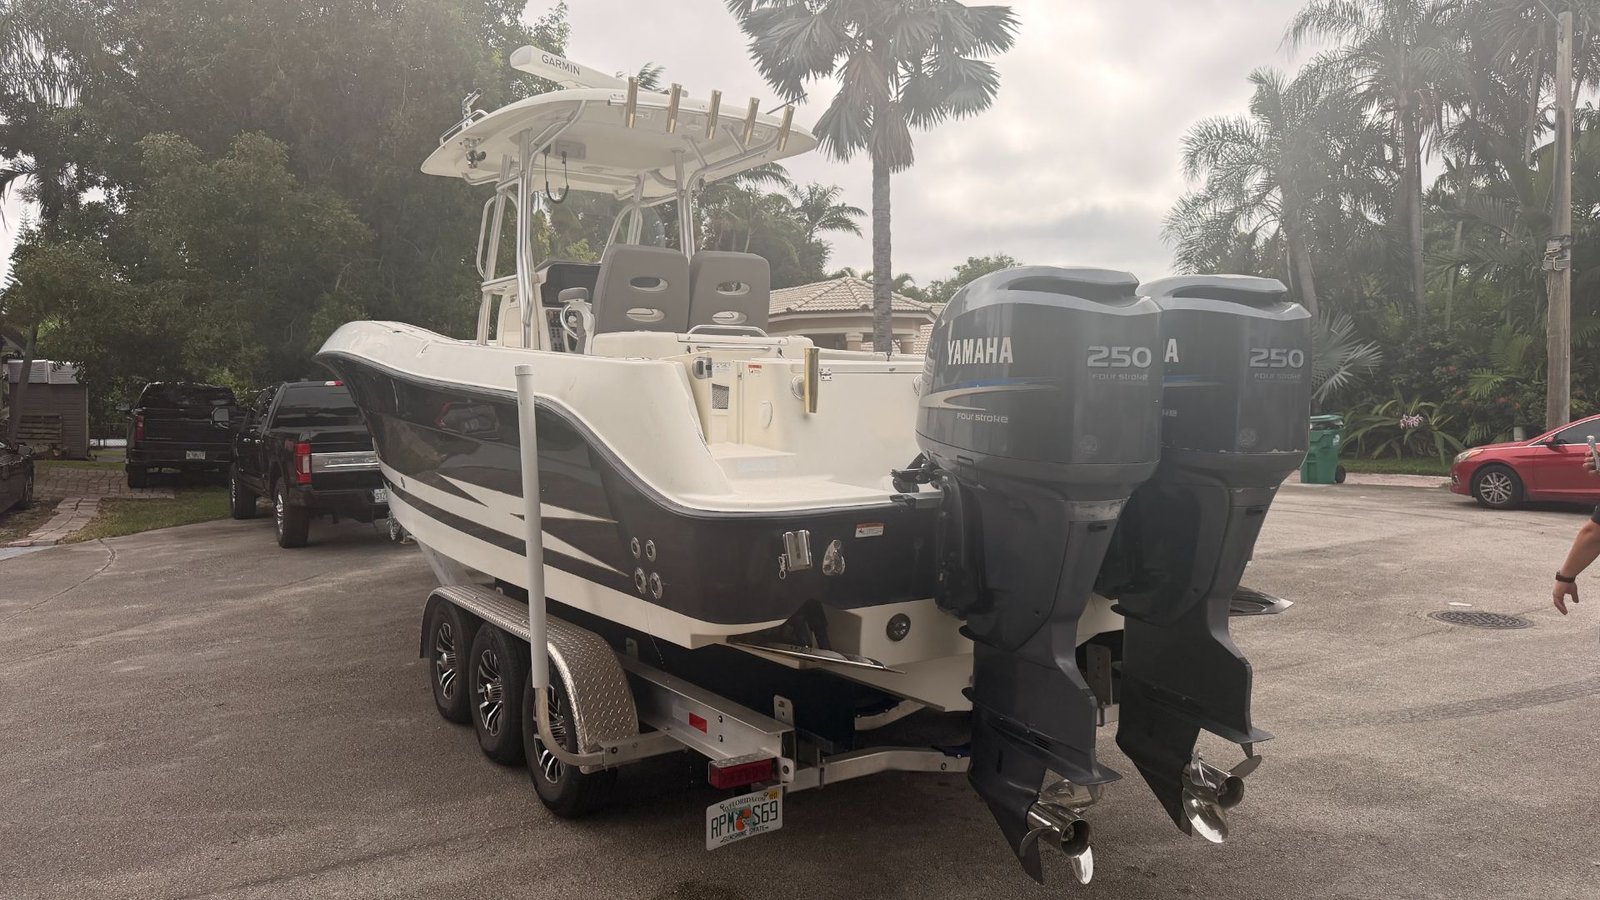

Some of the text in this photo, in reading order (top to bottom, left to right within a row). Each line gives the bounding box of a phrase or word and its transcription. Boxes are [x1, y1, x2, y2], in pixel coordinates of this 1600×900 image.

[541, 54, 580, 76] GARMIN
[947, 336, 1013, 365] YAMAHA
[1087, 345, 1152, 368] 250
[1249, 347, 1304, 368] 250
[711, 800, 778, 839] RPM S69
